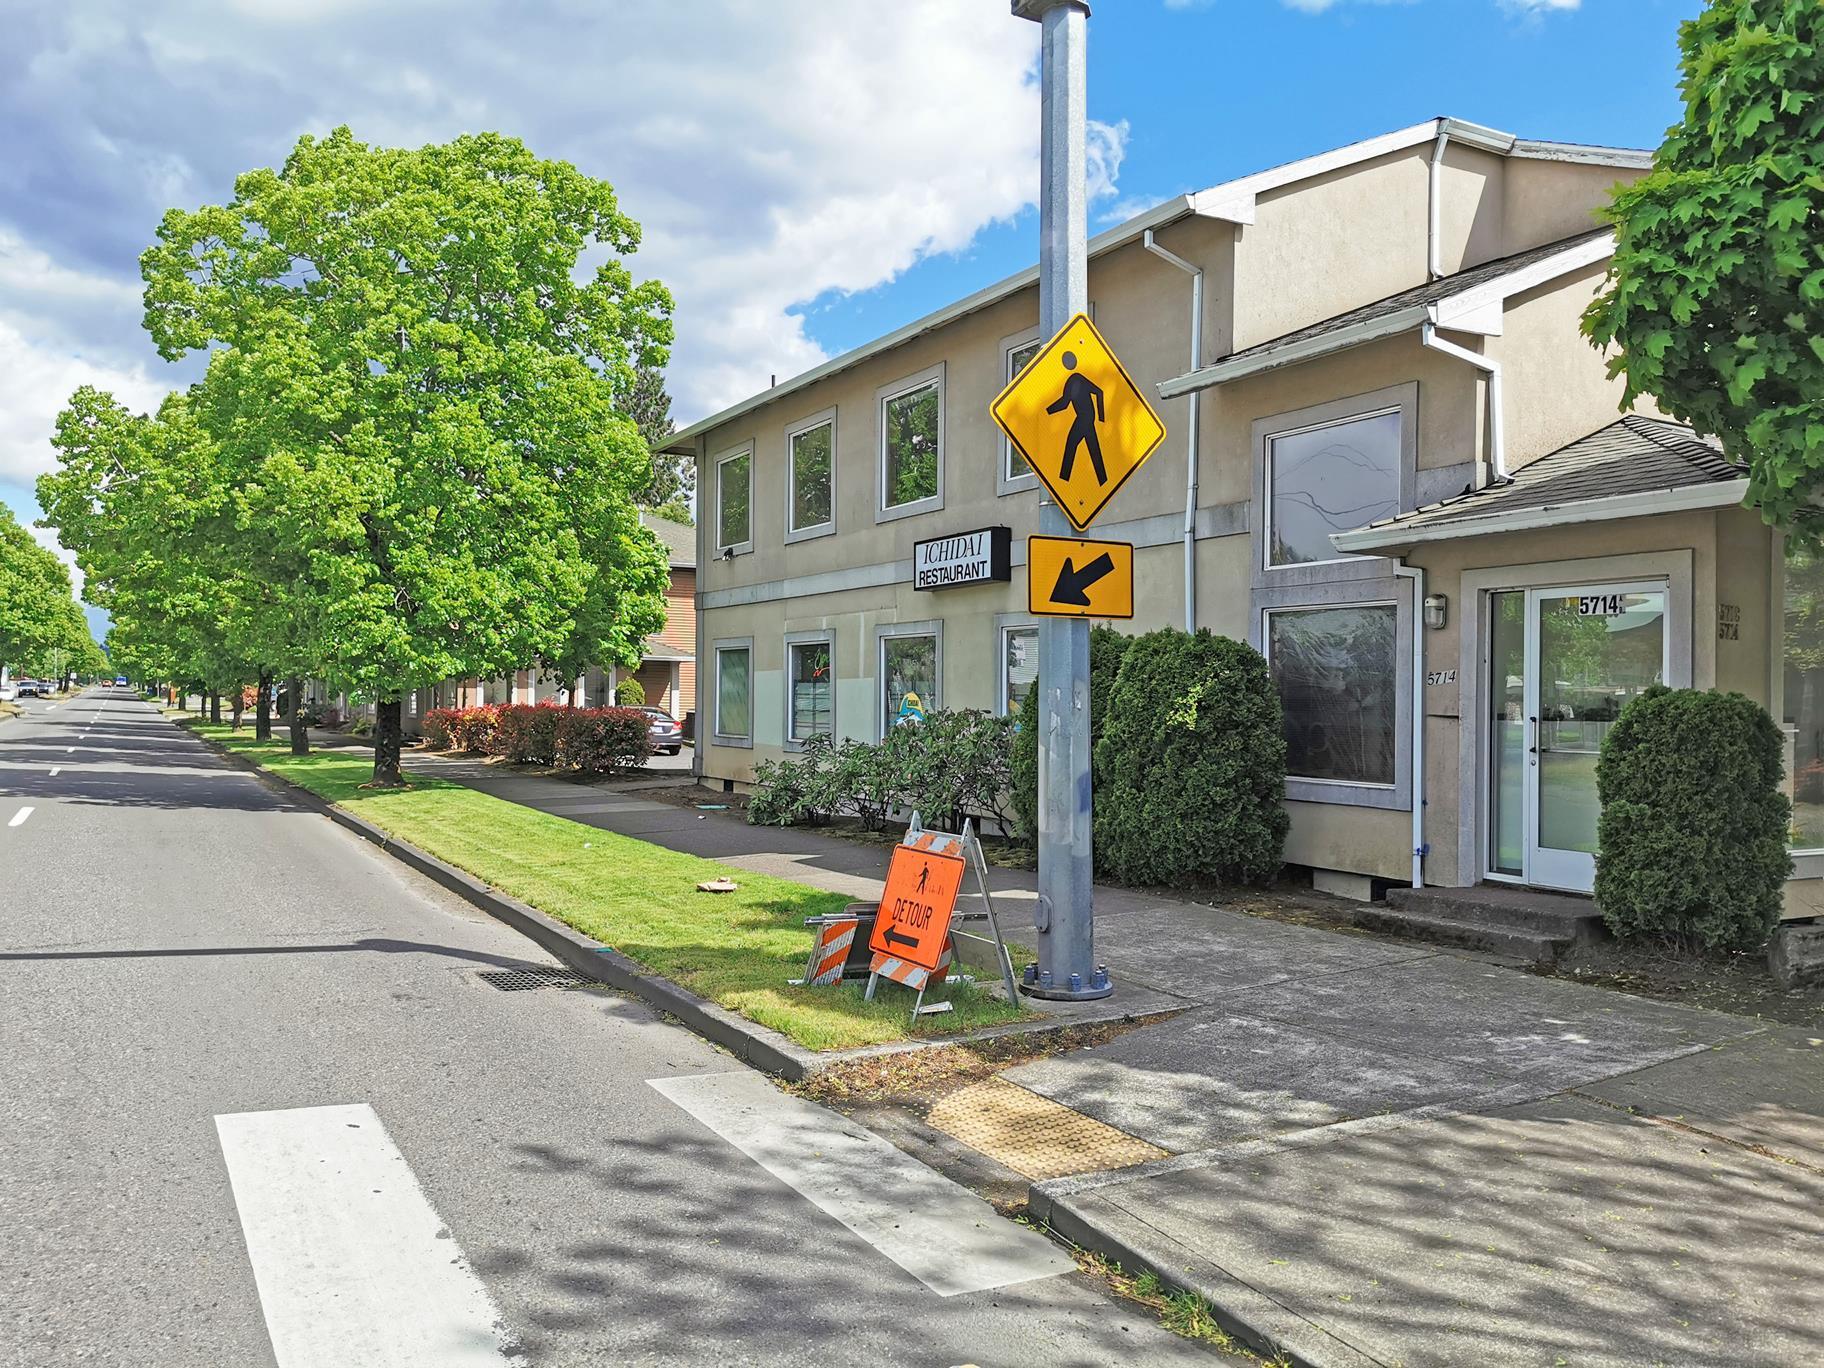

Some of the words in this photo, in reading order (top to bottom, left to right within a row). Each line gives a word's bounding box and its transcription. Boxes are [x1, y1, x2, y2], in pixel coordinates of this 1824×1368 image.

[923, 534, 984, 564] ICHIDAI
[919, 560, 988, 586] RESTAURANT
[1579, 594, 1619, 614] 5714
[1427, 670, 1456, 686] 5714
[892, 897, 933, 931] DETOUR
